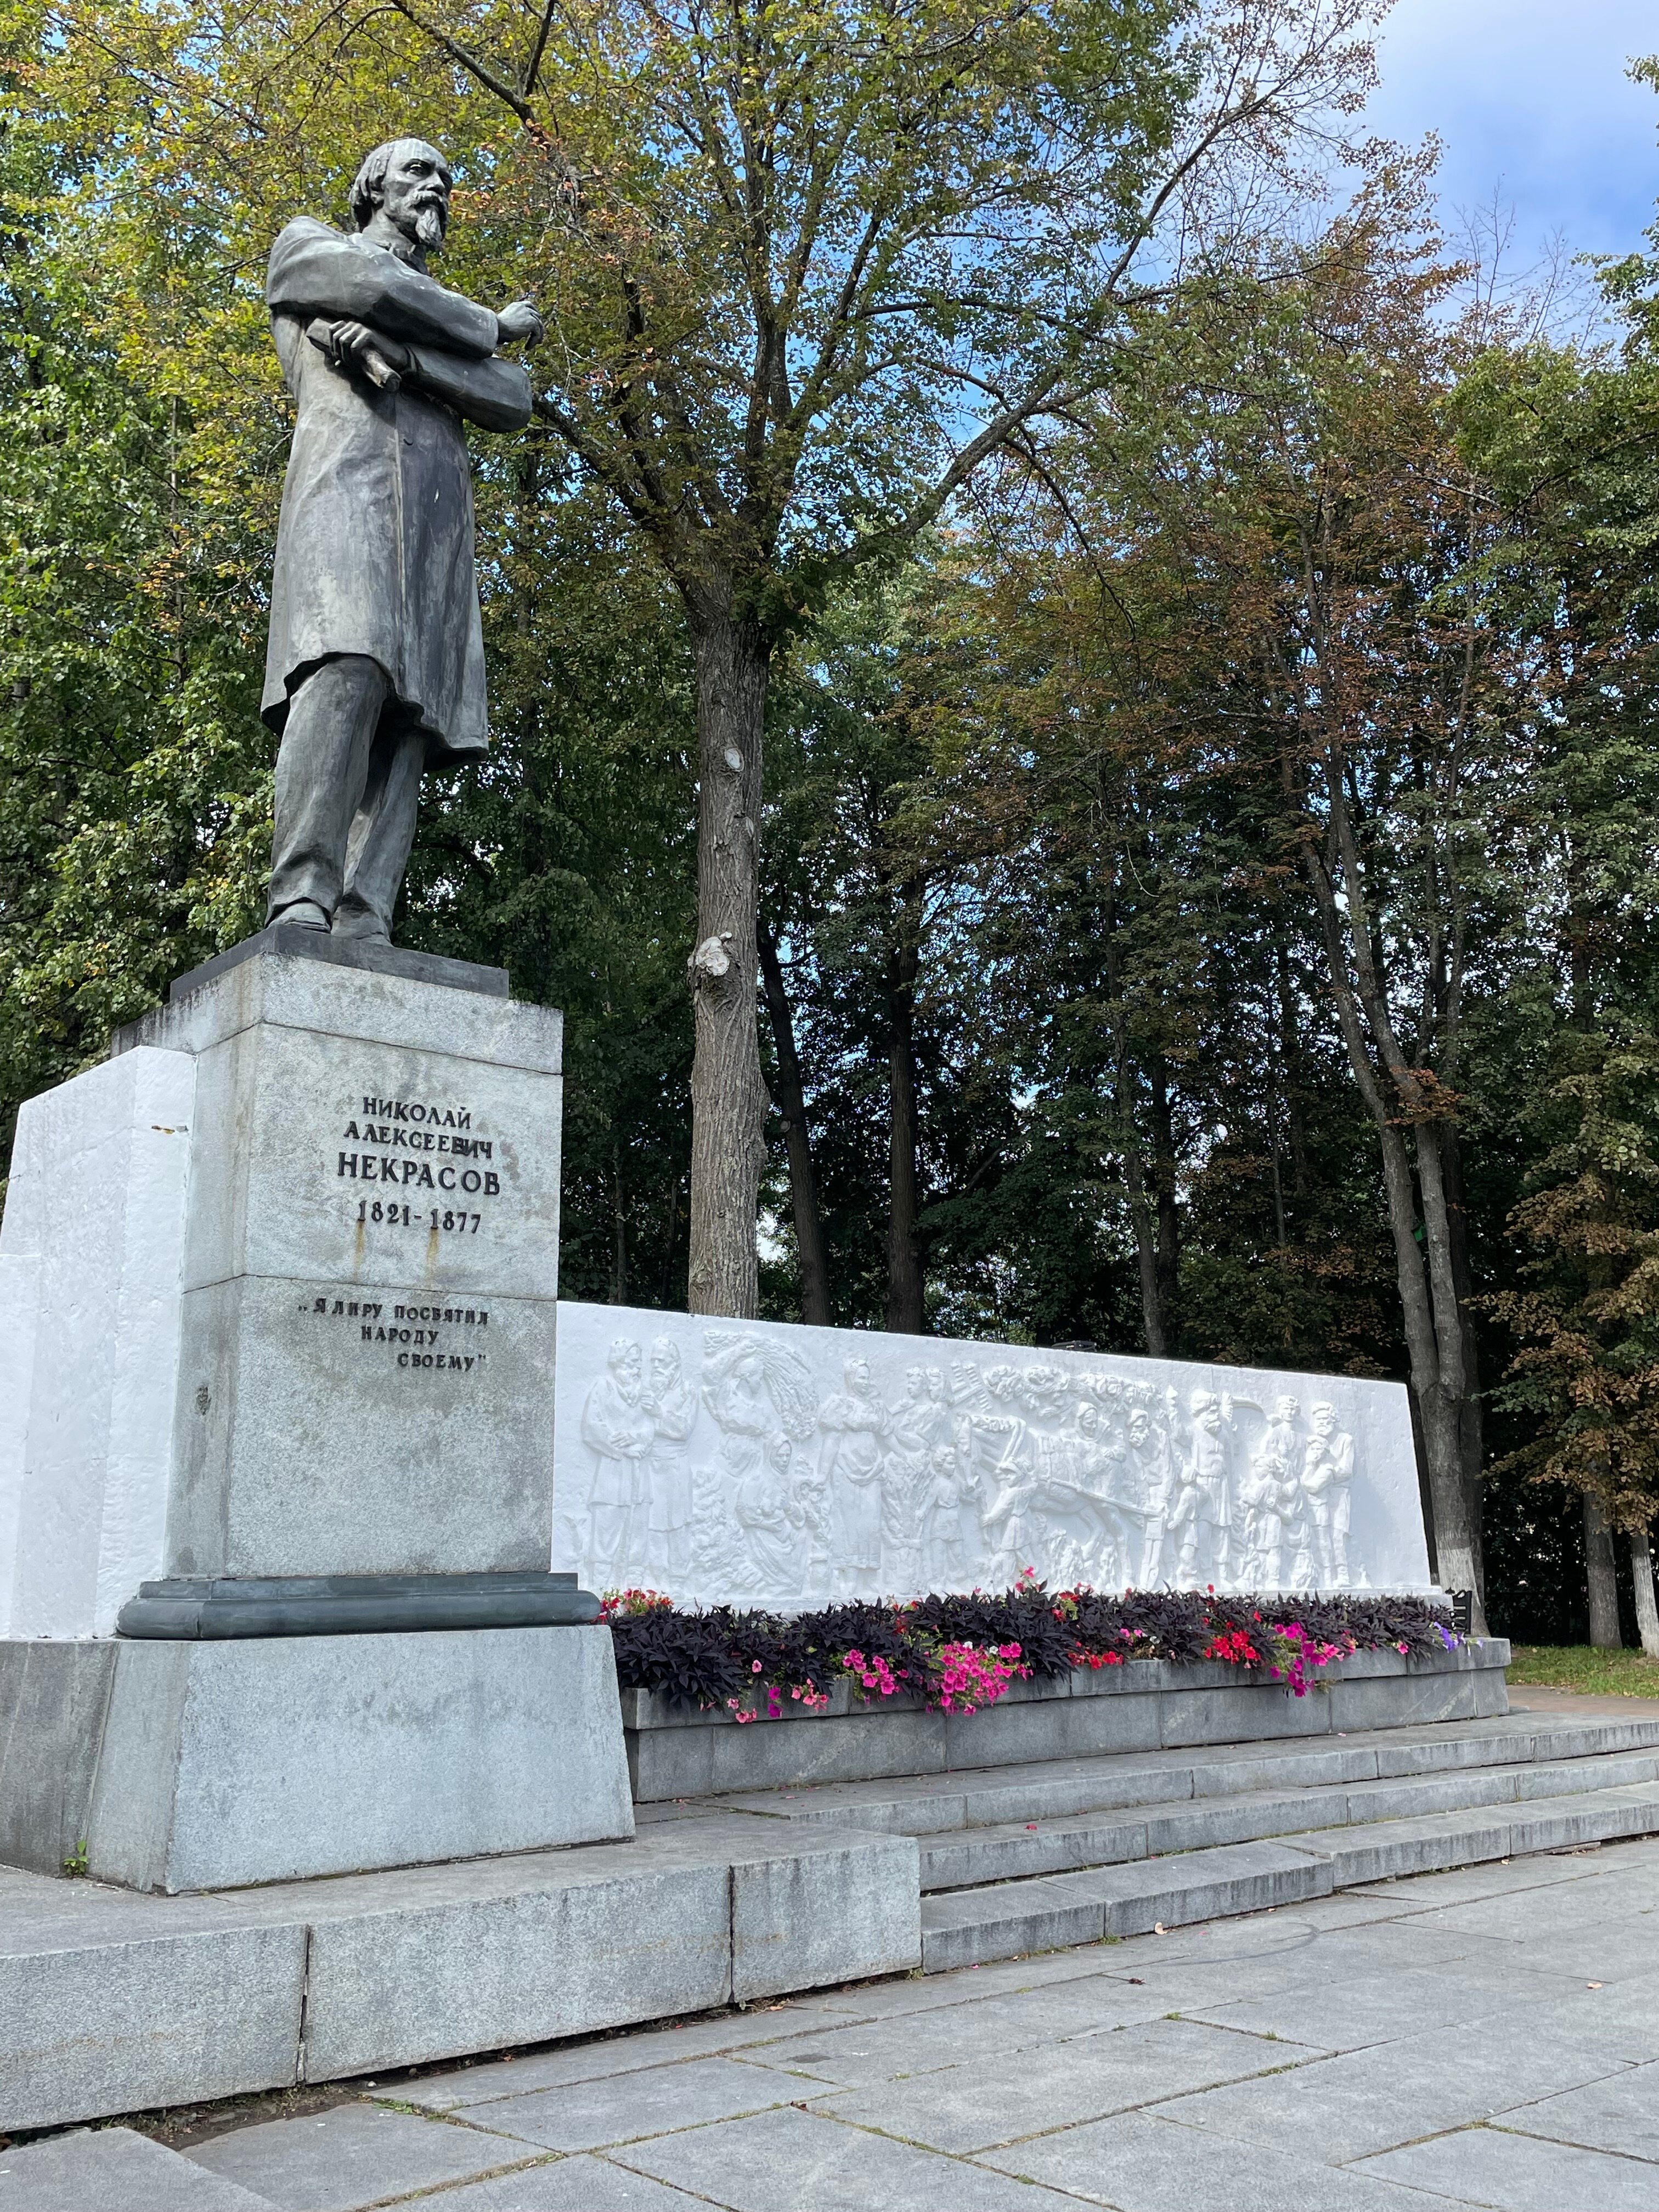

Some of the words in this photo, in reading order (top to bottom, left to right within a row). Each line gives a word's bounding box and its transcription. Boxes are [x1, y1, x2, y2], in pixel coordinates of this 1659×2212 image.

[363, 1097, 471, 1129] НИКОЛАЙ
[343, 1121, 493, 1159] АЛЕКСЕЕВИЧ
[337, 1152, 500, 1195] НЕКРАСОВ
[332, 1301, 383, 1319] ЛИРУ
[394, 1305, 489, 1325] ПОСВЯТИЛ
[362, 1325, 439, 1345] НАРОДУ
